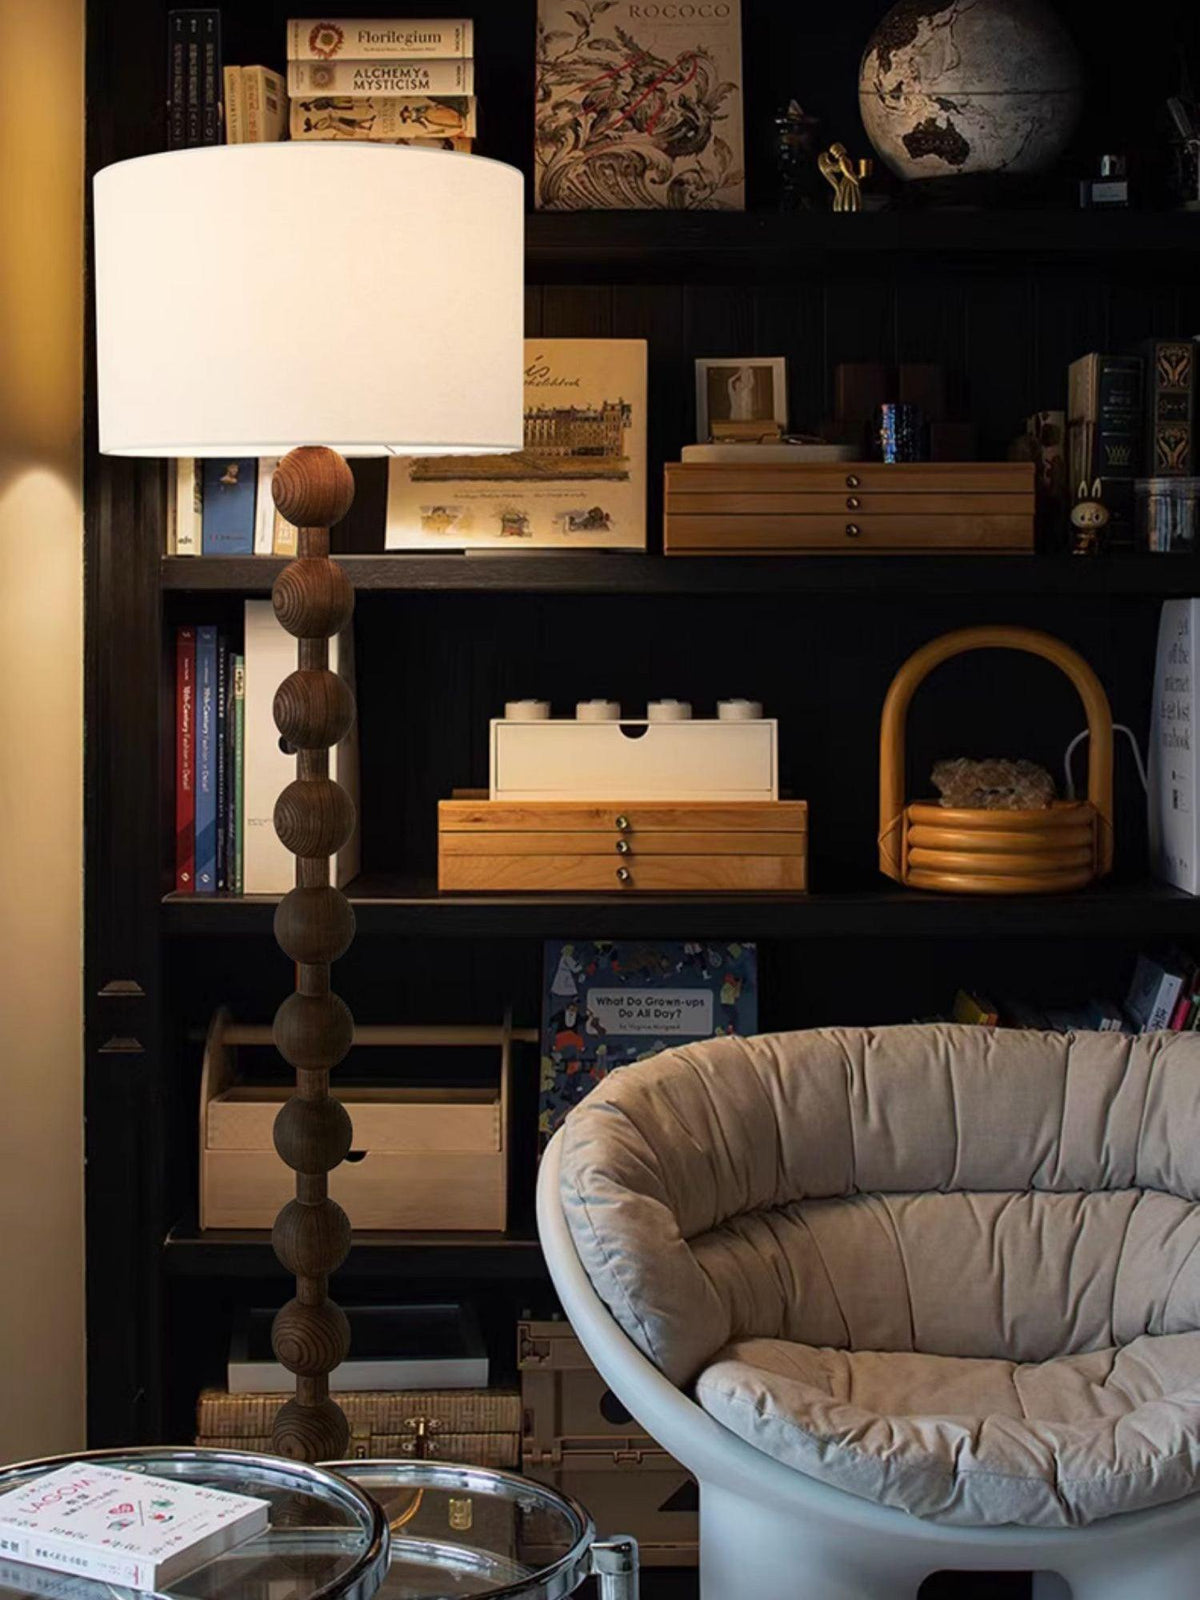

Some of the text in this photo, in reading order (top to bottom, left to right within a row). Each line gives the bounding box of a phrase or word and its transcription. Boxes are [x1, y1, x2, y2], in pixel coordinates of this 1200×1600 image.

[629, 4, 731, 19] ROCOCO
[357, 30, 442, 46] Florilegium
[353, 68, 430, 79] ALCHEMY &
[353, 79, 431, 90] MYSTICISM
[596, 996, 705, 1009] What Do Grown-ups
[618, 1009, 682, 1020] Do All Day?
